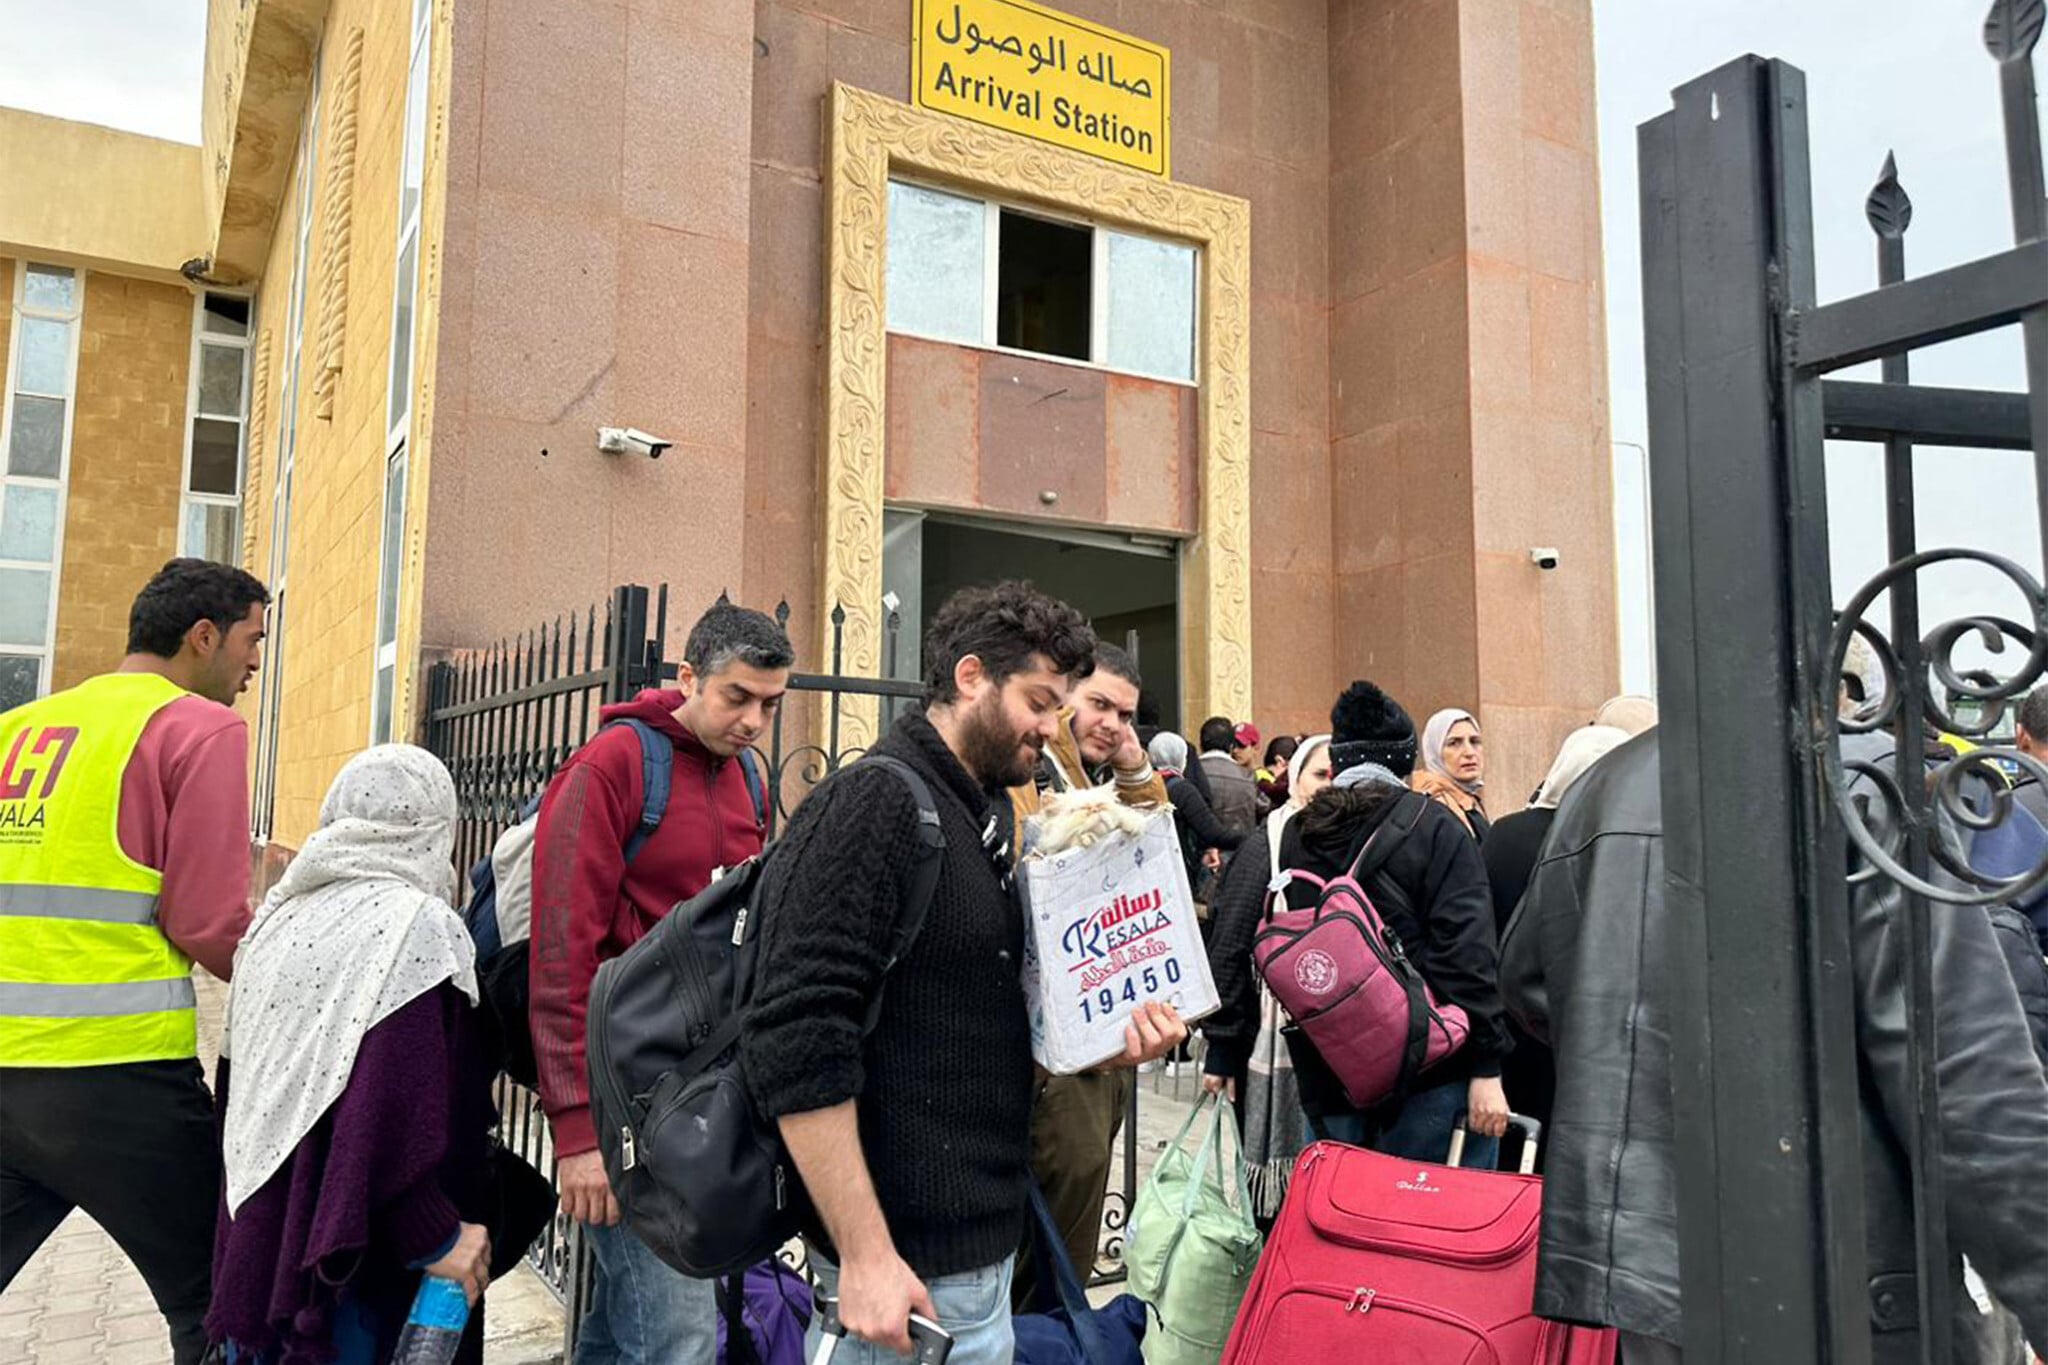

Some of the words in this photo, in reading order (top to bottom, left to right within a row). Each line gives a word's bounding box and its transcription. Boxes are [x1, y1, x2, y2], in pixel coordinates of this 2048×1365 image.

[936, 5, 1066, 75] الوصول
[935, 62, 1040, 120] Arrival
[1053, 97, 1153, 154] Station
[1062, 911, 1171, 958] RESALA
[1101, 888, 1162, 930] رسالة
[1079, 957, 1181, 1023] 19450
